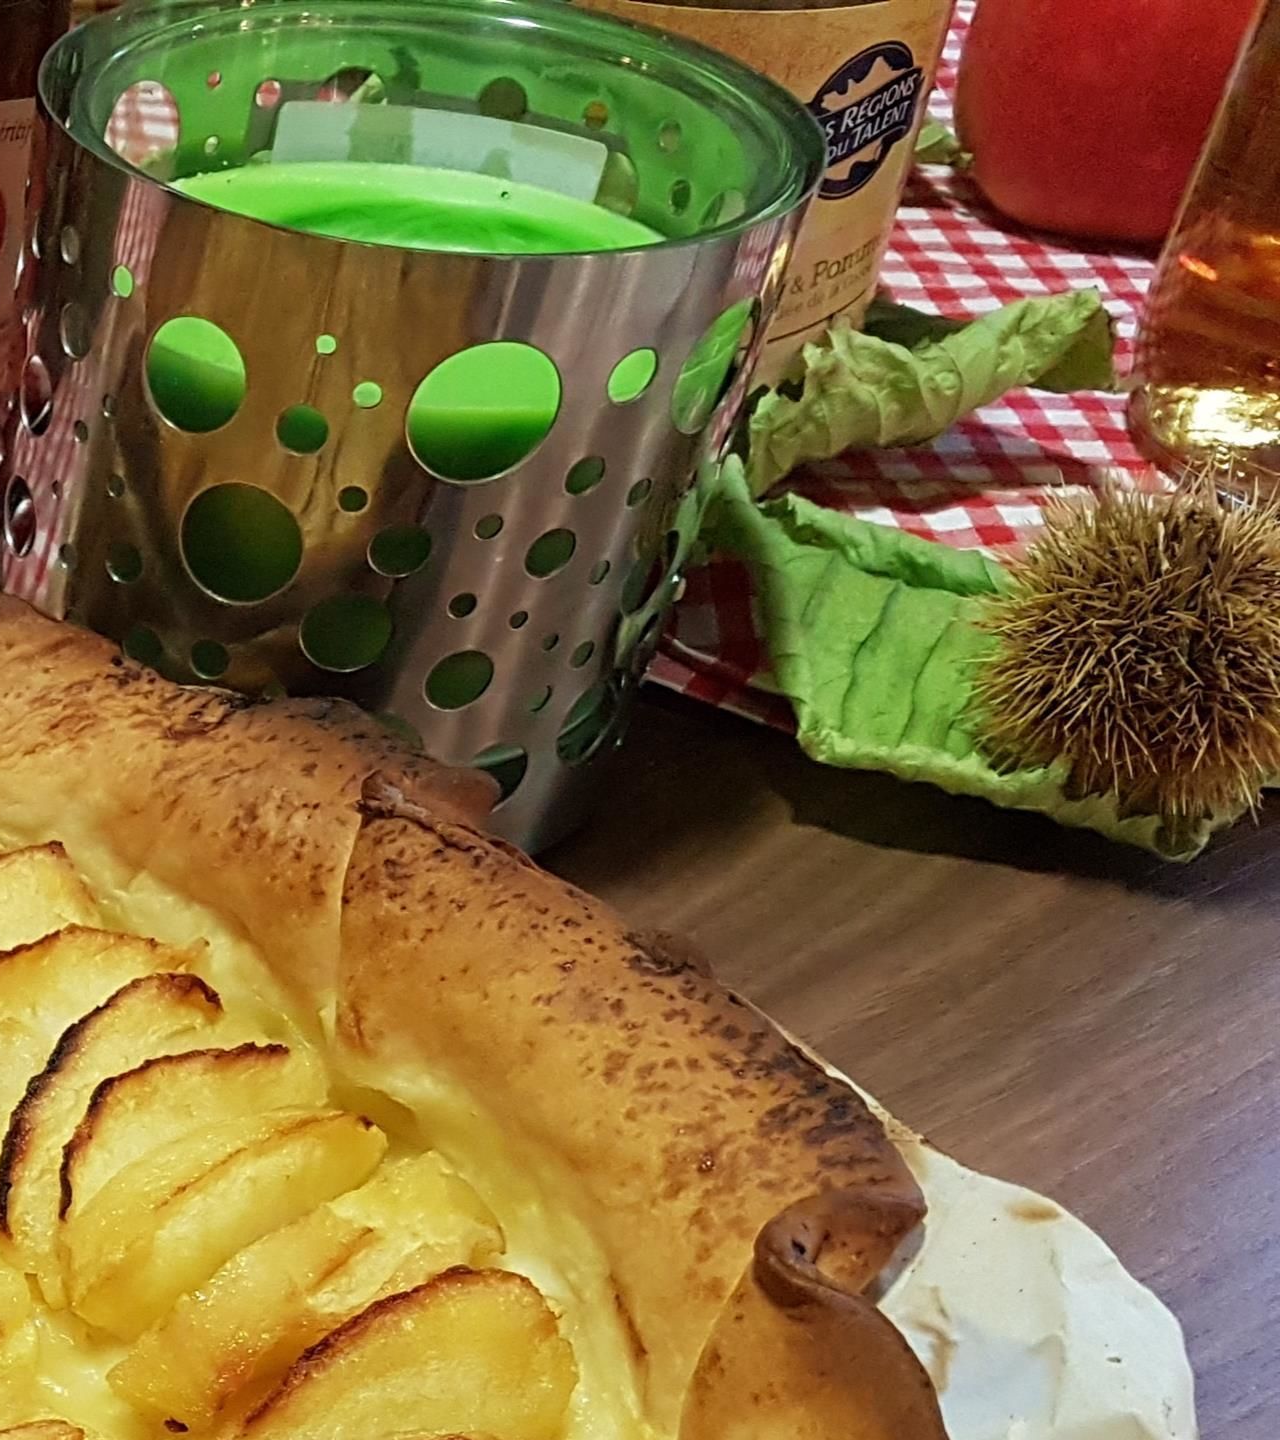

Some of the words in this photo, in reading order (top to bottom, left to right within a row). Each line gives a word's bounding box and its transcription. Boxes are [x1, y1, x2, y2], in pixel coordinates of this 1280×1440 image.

[840, 73, 918, 134] RÉGIONS
[851, 100, 911, 149] TALENT
[790, 275, 803, 294] &
